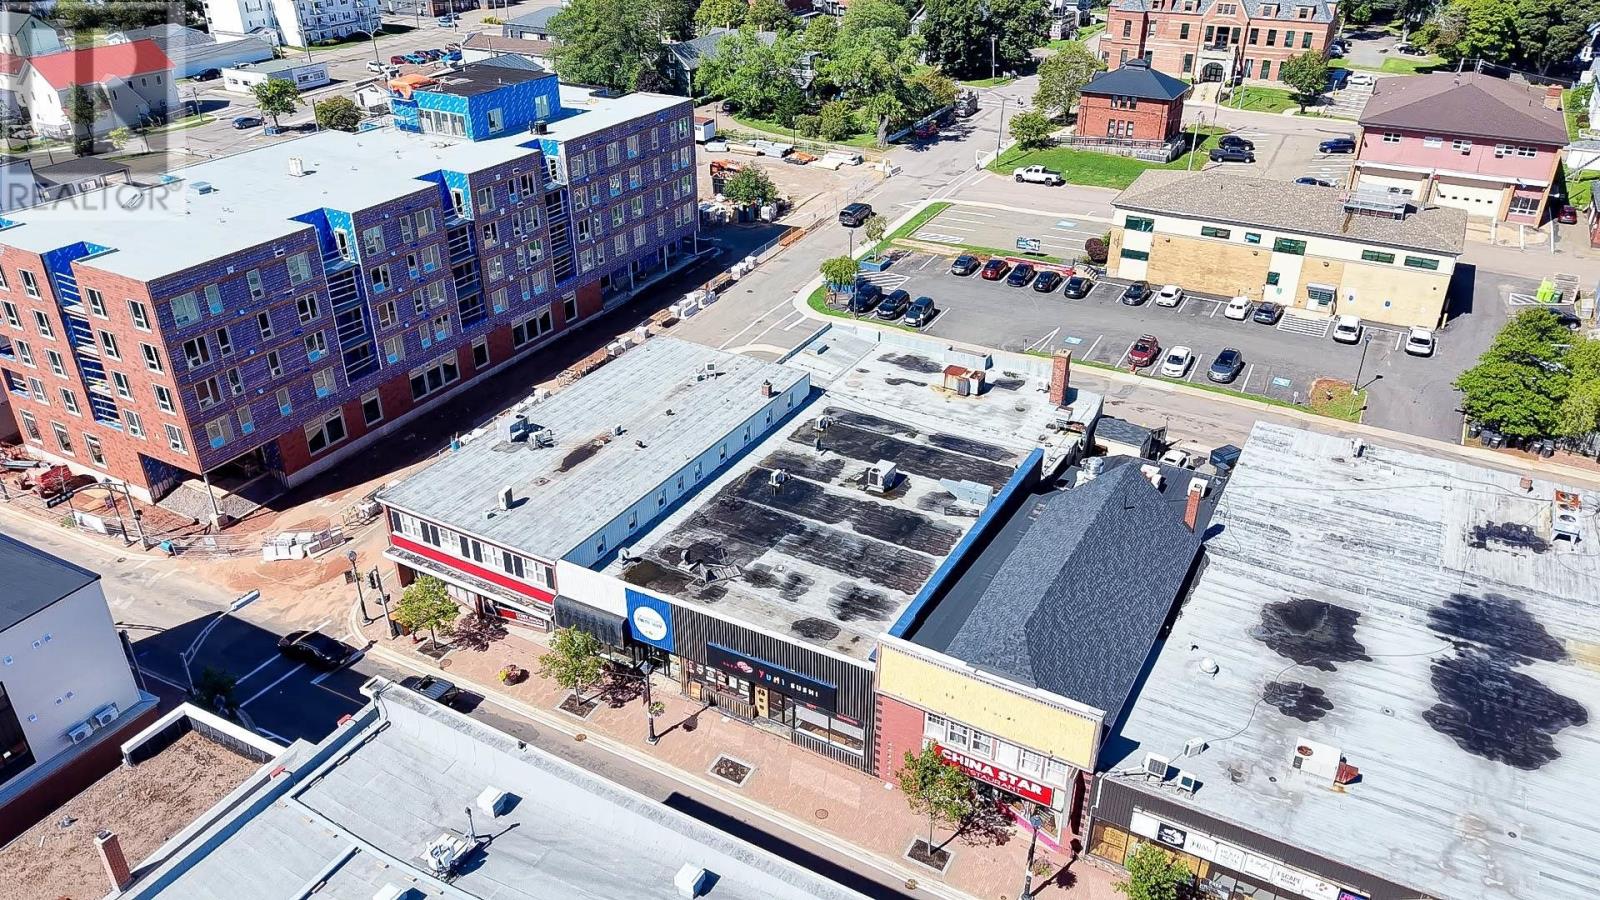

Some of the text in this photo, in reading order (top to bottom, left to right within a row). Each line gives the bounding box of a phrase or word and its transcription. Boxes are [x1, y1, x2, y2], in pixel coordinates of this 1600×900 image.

[790, 682, 818, 698] SUSHI
[941, 749, 1043, 796] CHINA STAR
